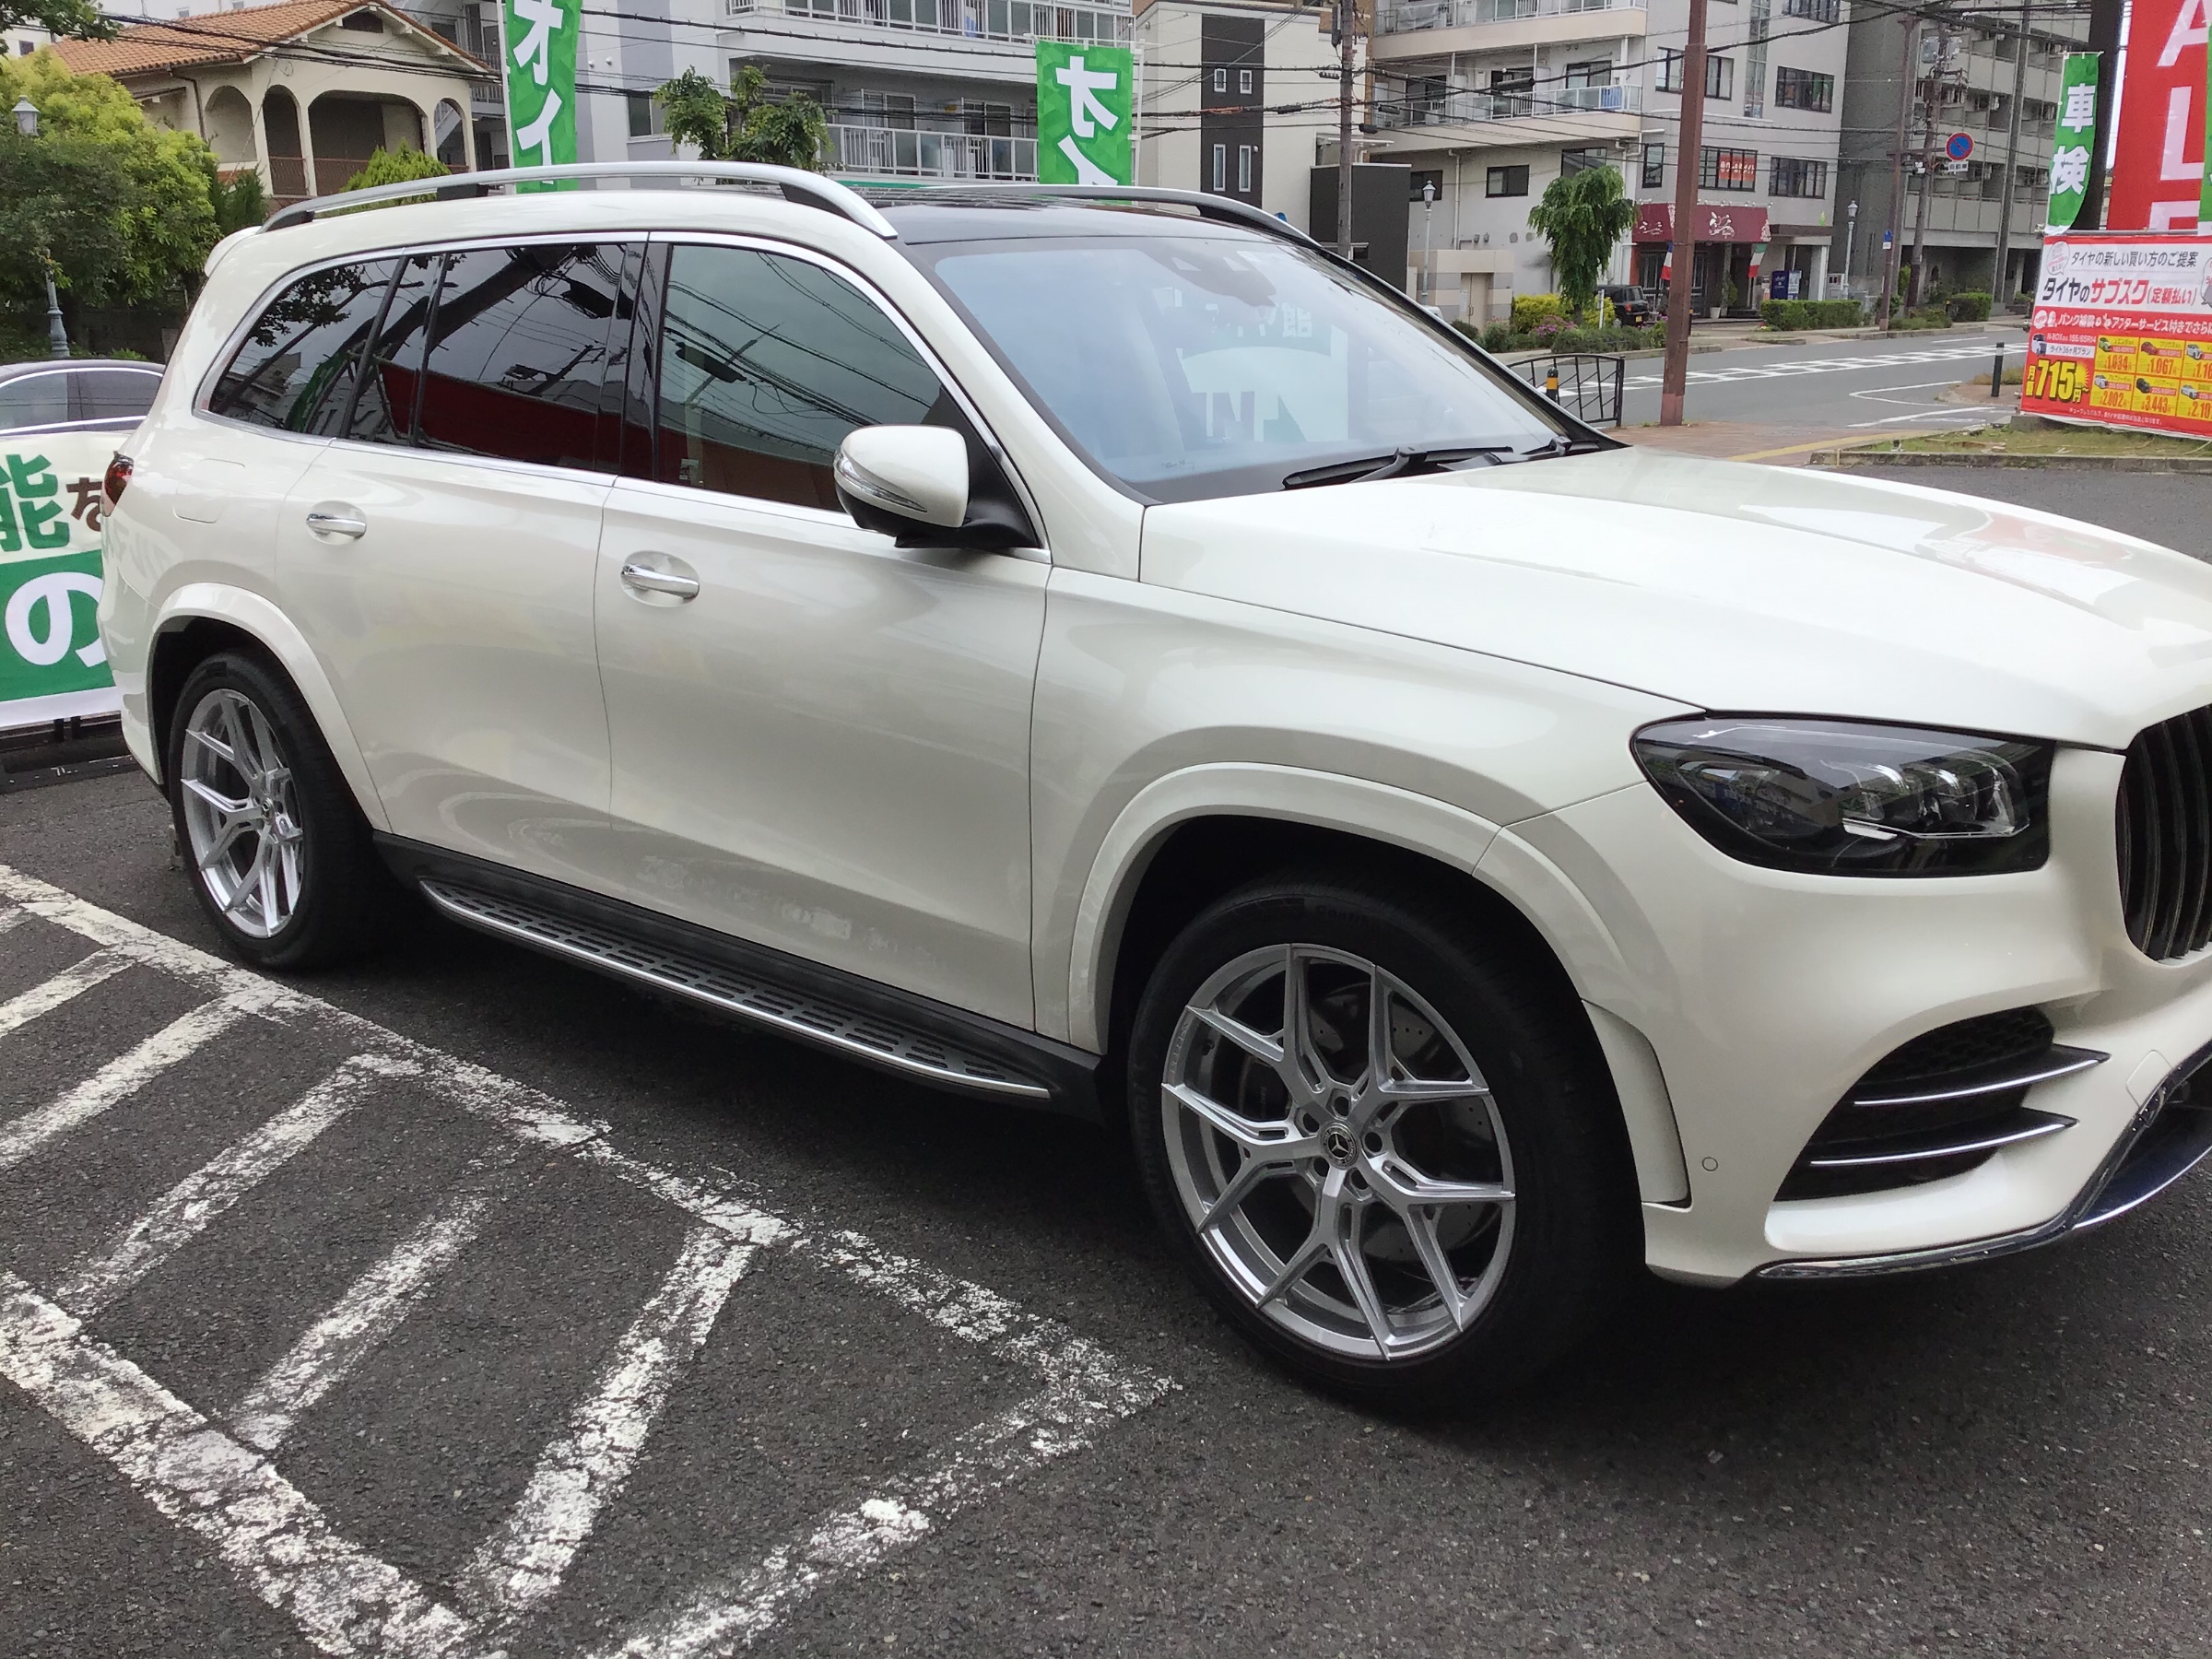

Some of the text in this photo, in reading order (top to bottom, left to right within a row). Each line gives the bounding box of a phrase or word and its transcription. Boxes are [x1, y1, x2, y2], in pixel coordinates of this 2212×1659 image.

[2049, 83, 2096, 195] 車検
[2071, 251, 2199, 267] タイヤの新しい買い方のご提案
[6, 571, 108, 668] の
